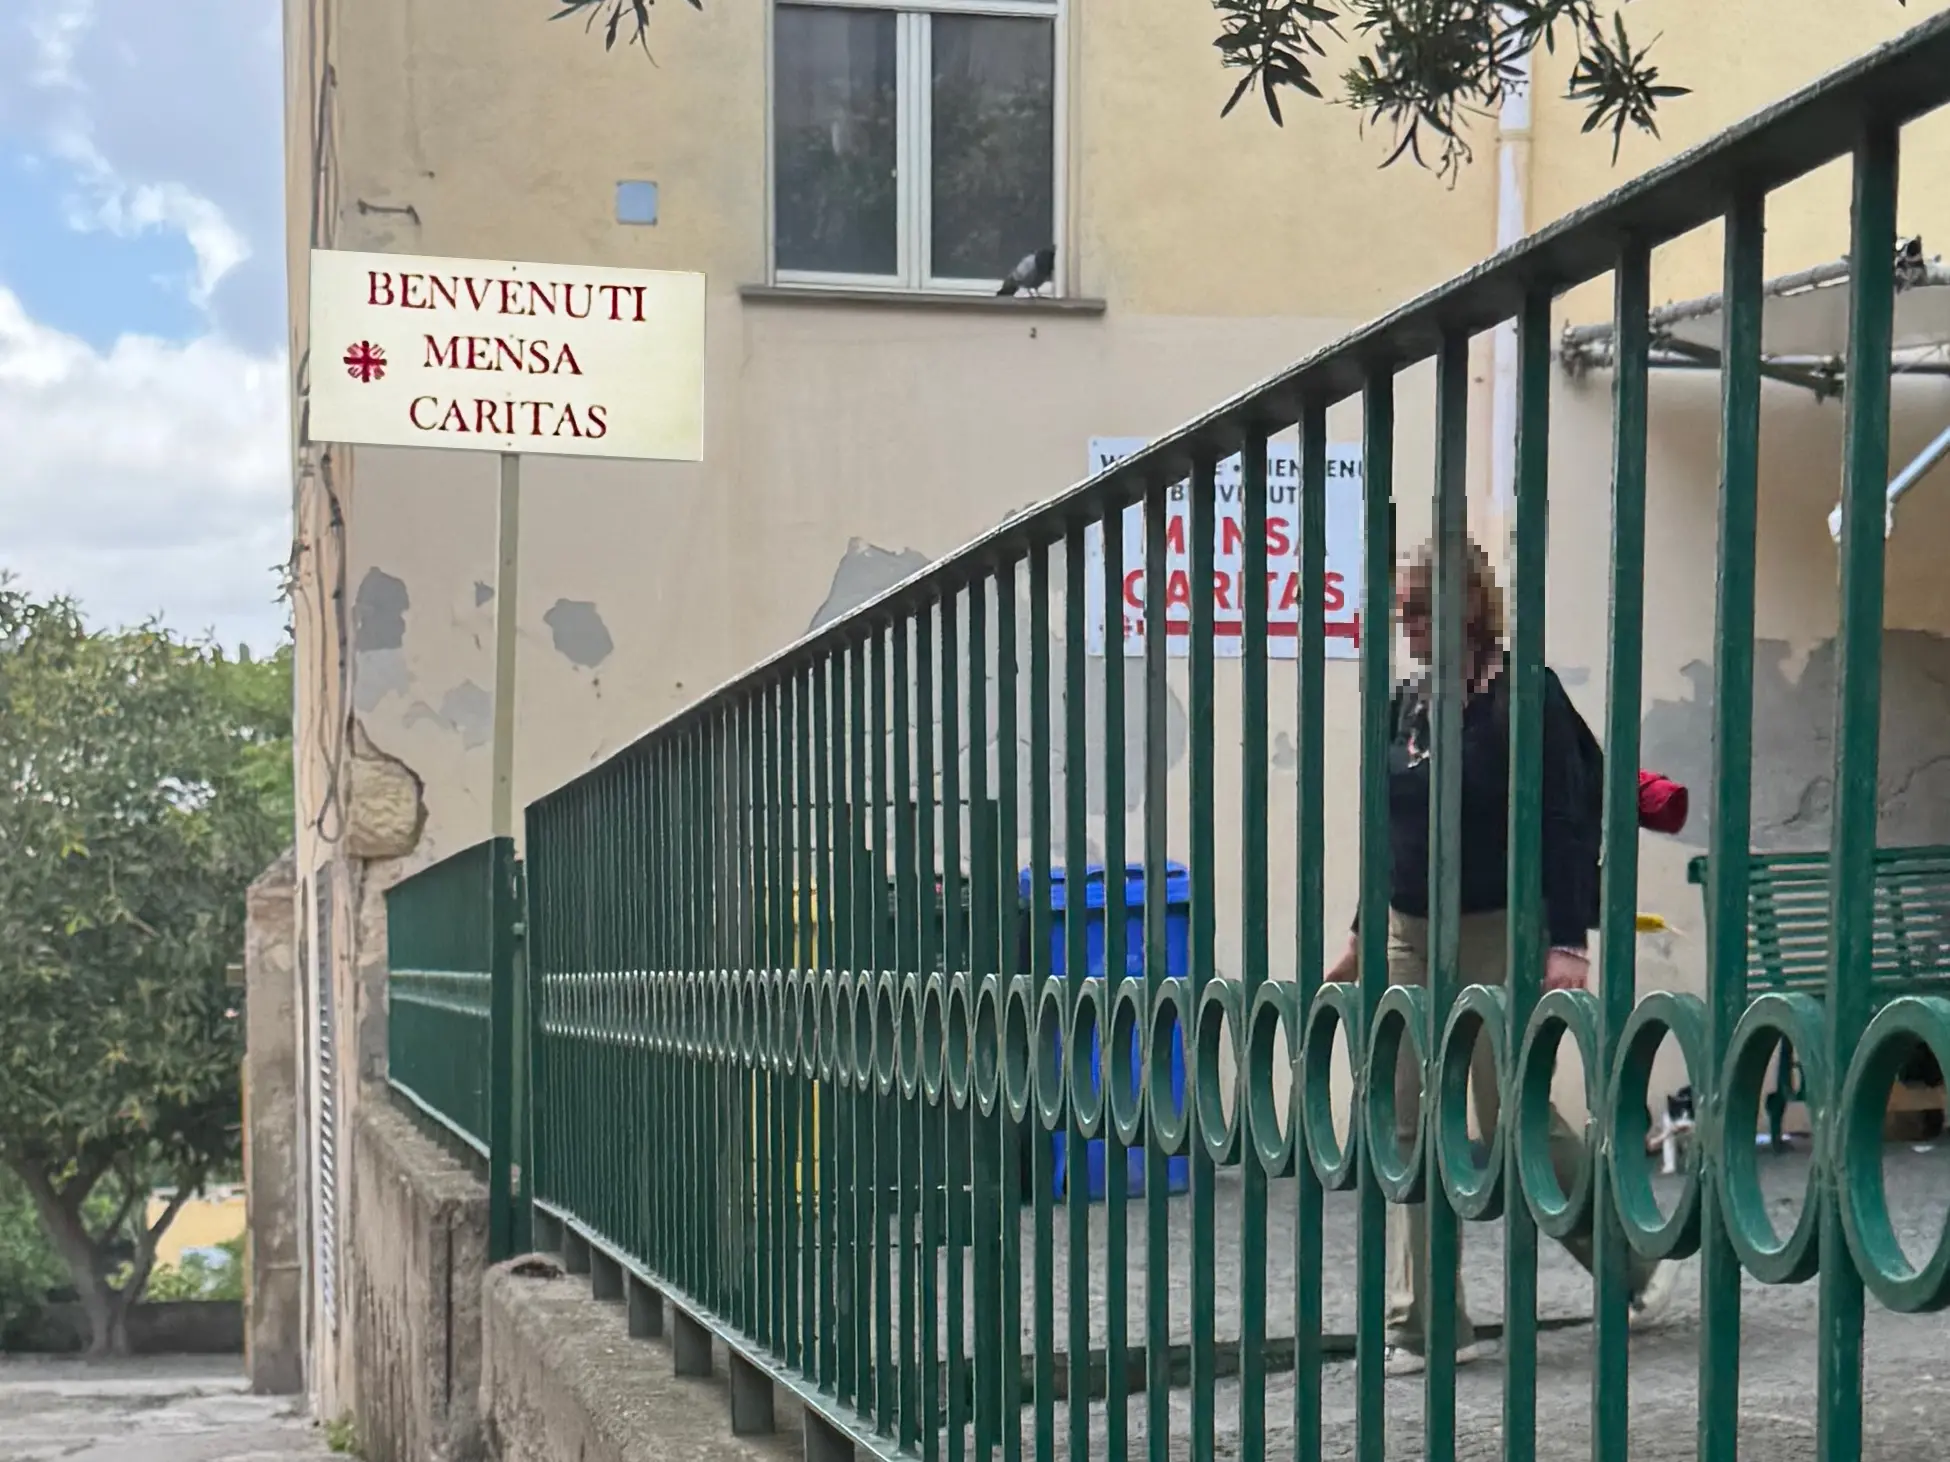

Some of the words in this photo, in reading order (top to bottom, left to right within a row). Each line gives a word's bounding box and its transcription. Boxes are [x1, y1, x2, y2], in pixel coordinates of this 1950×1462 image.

[367, 271, 647, 322] BENVENUTI
[423, 334, 583, 376] MENSA
[409, 396, 608, 439] CARITAS
